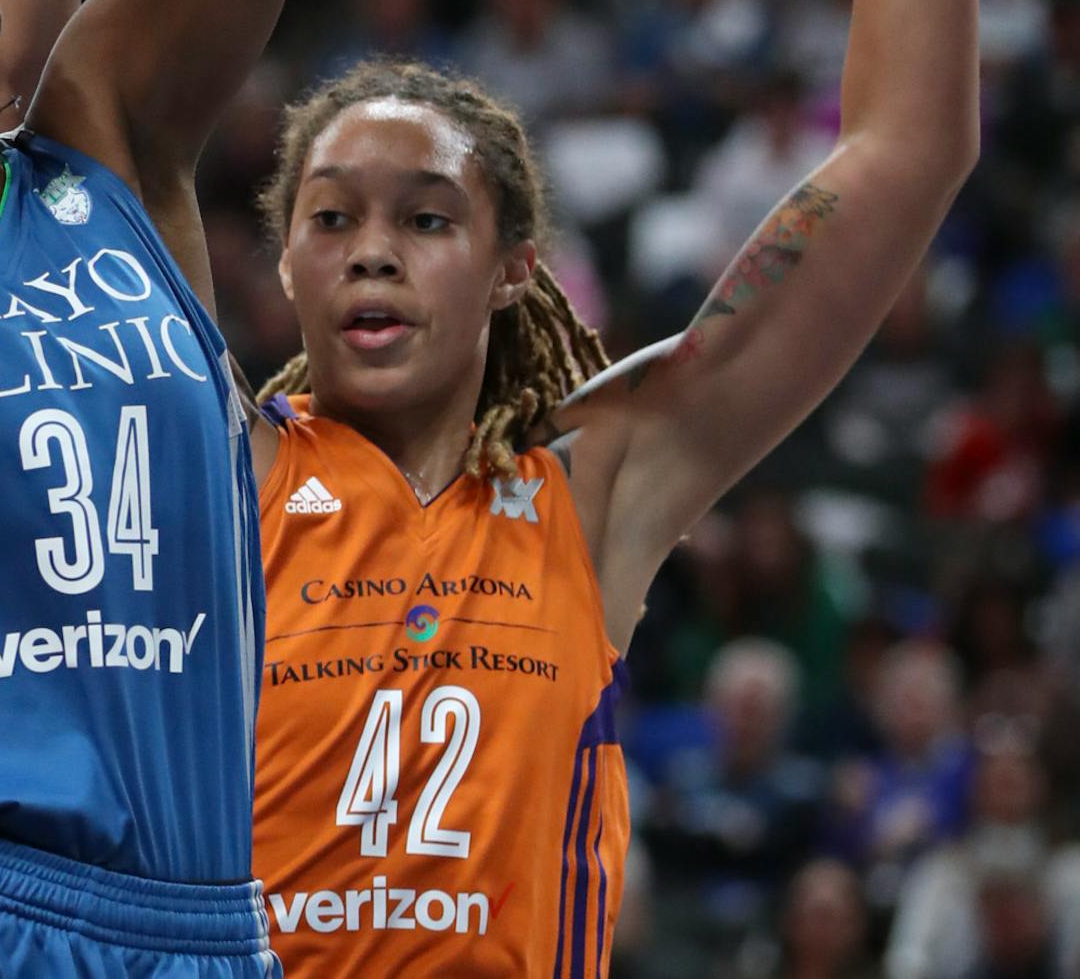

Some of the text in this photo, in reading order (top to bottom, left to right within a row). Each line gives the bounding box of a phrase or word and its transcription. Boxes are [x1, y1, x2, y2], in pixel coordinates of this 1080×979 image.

[19, 405, 159, 595] 34
[284, 498, 343, 514] adidas
[301, 572, 534, 605] CASINO ARIZONA
[264, 644, 560, 687] TALKING STICK RESORT
[335, 684, 481, 859] 42
[268, 875, 489, 936] verizon
